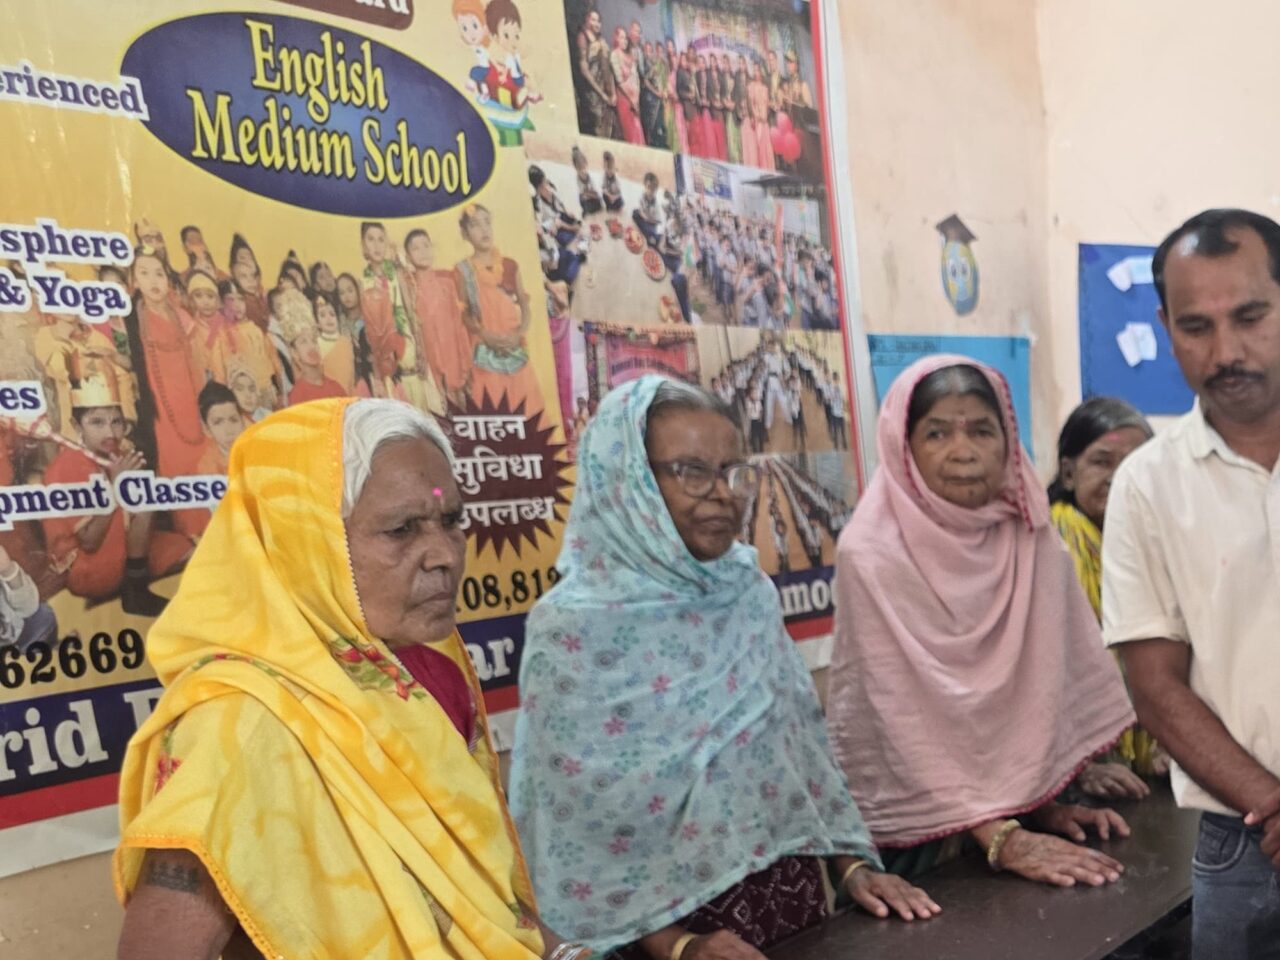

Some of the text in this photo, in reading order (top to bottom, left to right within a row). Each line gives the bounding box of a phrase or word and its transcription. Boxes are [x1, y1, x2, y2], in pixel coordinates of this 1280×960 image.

[0, 65, 143, 113] rienced
[245, 19, 388, 123] English
[186, 89, 471, 195] Medium School
[0, 224, 129, 262] sphere
[33, 275, 126, 317] Yoga
[0, 387, 41, 410] es
[453, 415, 527, 441] वाहन
[453, 444, 543, 495] सुविधा
[0, 628, 145, 688] 62669
